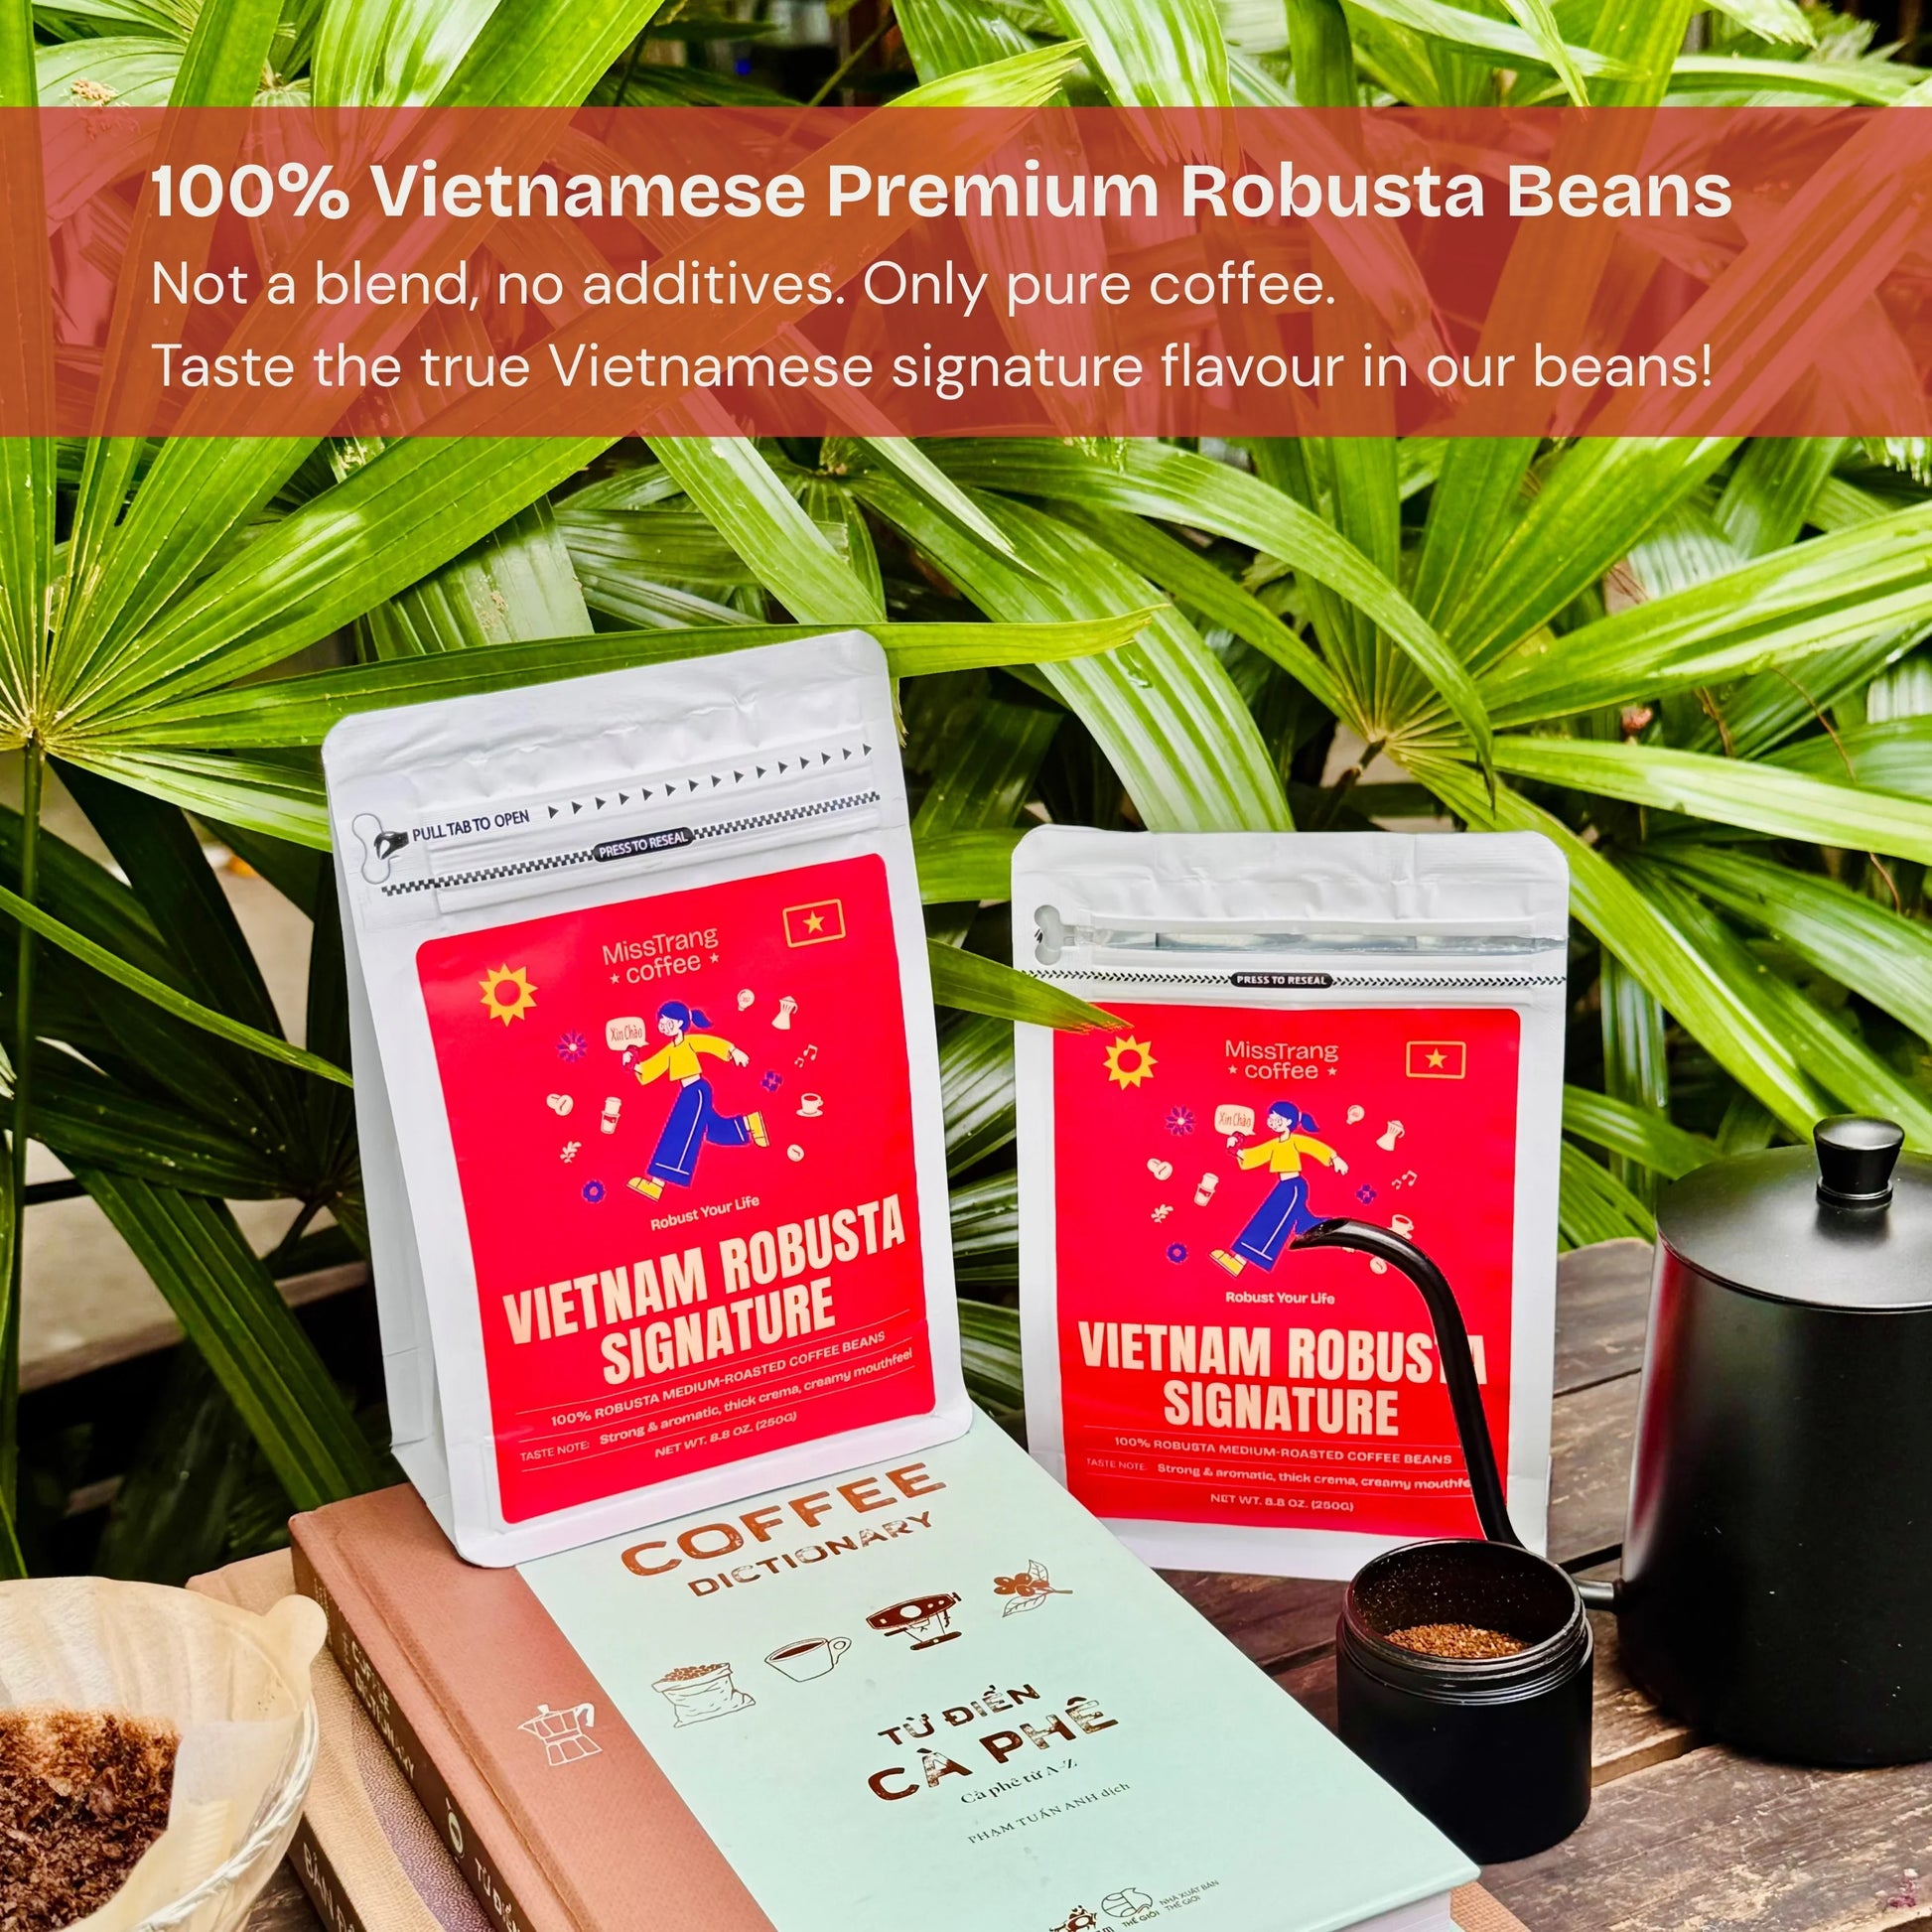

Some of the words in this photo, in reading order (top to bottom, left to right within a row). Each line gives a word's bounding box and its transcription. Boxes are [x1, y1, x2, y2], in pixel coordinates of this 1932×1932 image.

[412, 825, 447, 842] PULL
[447, 820, 472, 836] TAB
[473, 817, 491, 831] TO
[494, 810, 530, 828] OPEN
[599, 840, 631, 859] PRESS
[630, 838, 648, 852] TO
[649, 833, 689, 850] RESEAL
[602, 927, 719, 967] MissTrang
[625, 953, 702, 985] coffee
[1236, 974, 1270, 986] PRESS
[1271, 975, 1286, 986] TO
[1288, 975, 1327, 987] RESEAL
[611, 1027, 624, 1041] Xin
[1225, 1039, 1339, 1063] MissTrang
[1244, 1061, 1319, 1080] coffee
[1218, 1111, 1232, 1127] Xin
[650, 1208, 699, 1231] Robust
[700, 1201, 733, 1220] Your
[735, 1194, 760, 1211] Life
[502, 1246, 708, 1345] VIETNAM
[719, 1193, 906, 1294] ROBUSTA
[1225, 1291, 1274, 1305] Robust
[1277, 1292, 1309, 1305] Your
[1311, 1293, 1335, 1306] Life
[600, 1277, 836, 1386] SIGNATURE
[1078, 1321, 1271, 1377] VIETNAM
[1288, 1328, 1488, 1385] ROBUSA
[551, 1408, 593, 1427] 100%
[594, 1392, 660, 1421] ROBUSTA
[662, 1359, 786, 1405] MEDIUM-ROASTED
[788, 1343, 840, 1369] COFFEE
[841, 1330, 887, 1354] BEANS
[520, 1445, 556, 1462] TASTE
[556, 1440, 592, 1456] NOTE:
[599, 1425, 645, 1447] Strong
[646, 1420, 659, 1433] &
[660, 1405, 723, 1431] aromatic,
[723, 1393, 759, 1414] thick
[758, 1383, 802, 1406] crema,
[803, 1369, 852, 1394] creamy
[853, 1346, 913, 1378] mouthfeel
[1163, 1379, 1400, 1437] SIGNATURE
[654, 1442, 682, 1458] NET
[682, 1435, 708, 1451] WT.
[709, 1429, 732, 1444] 8.8
[732, 1424, 755, 1438] OZ.
[756, 1410, 798, 1435] (250G)
[1114, 1437, 1152, 1449] 100%
[1154, 1440, 1216, 1453] ROBUSTA
[1218, 1445, 1344, 1460] MEDIUM-ROASTED
[1346, 1450, 1401, 1463] COFFEE
[1404, 1453, 1452, 1465] BEANS
[1086, 1456, 1116, 1468] TASTE
[1157, 1463, 1201, 1477] Strong
[1202, 1466, 1214, 1477] &
[1215, 1468, 1277, 1483] aromatic,
[1279, 1472, 1311, 1484] thick
[1313, 1475, 1359, 1487] crema,
[1360, 1477, 1412, 1491] creamy
[621, 1461, 947, 1577] COFFEE
[1210, 1493, 1236, 1504] NET
[1238, 1495, 1263, 1506] WT.
[1288, 1499, 1310, 1509] OZ.
[687, 1510, 932, 1597] DICTIONARY
[878, 1714, 936, 1745] TỪ
[942, 1684, 1040, 1727] ĐIỂN
[868, 1747, 974, 1802] CÀ
[979, 1696, 1120, 1764] PHÊ
[960, 1790, 988, 1805] Cà
[1045, 1758, 1078, 1777] A-Z
[967, 1822, 1016, 1844] PHẠM
[1064, 1793, 1099, 1811] ANH
[1100, 1782, 1131, 1798] dịch
